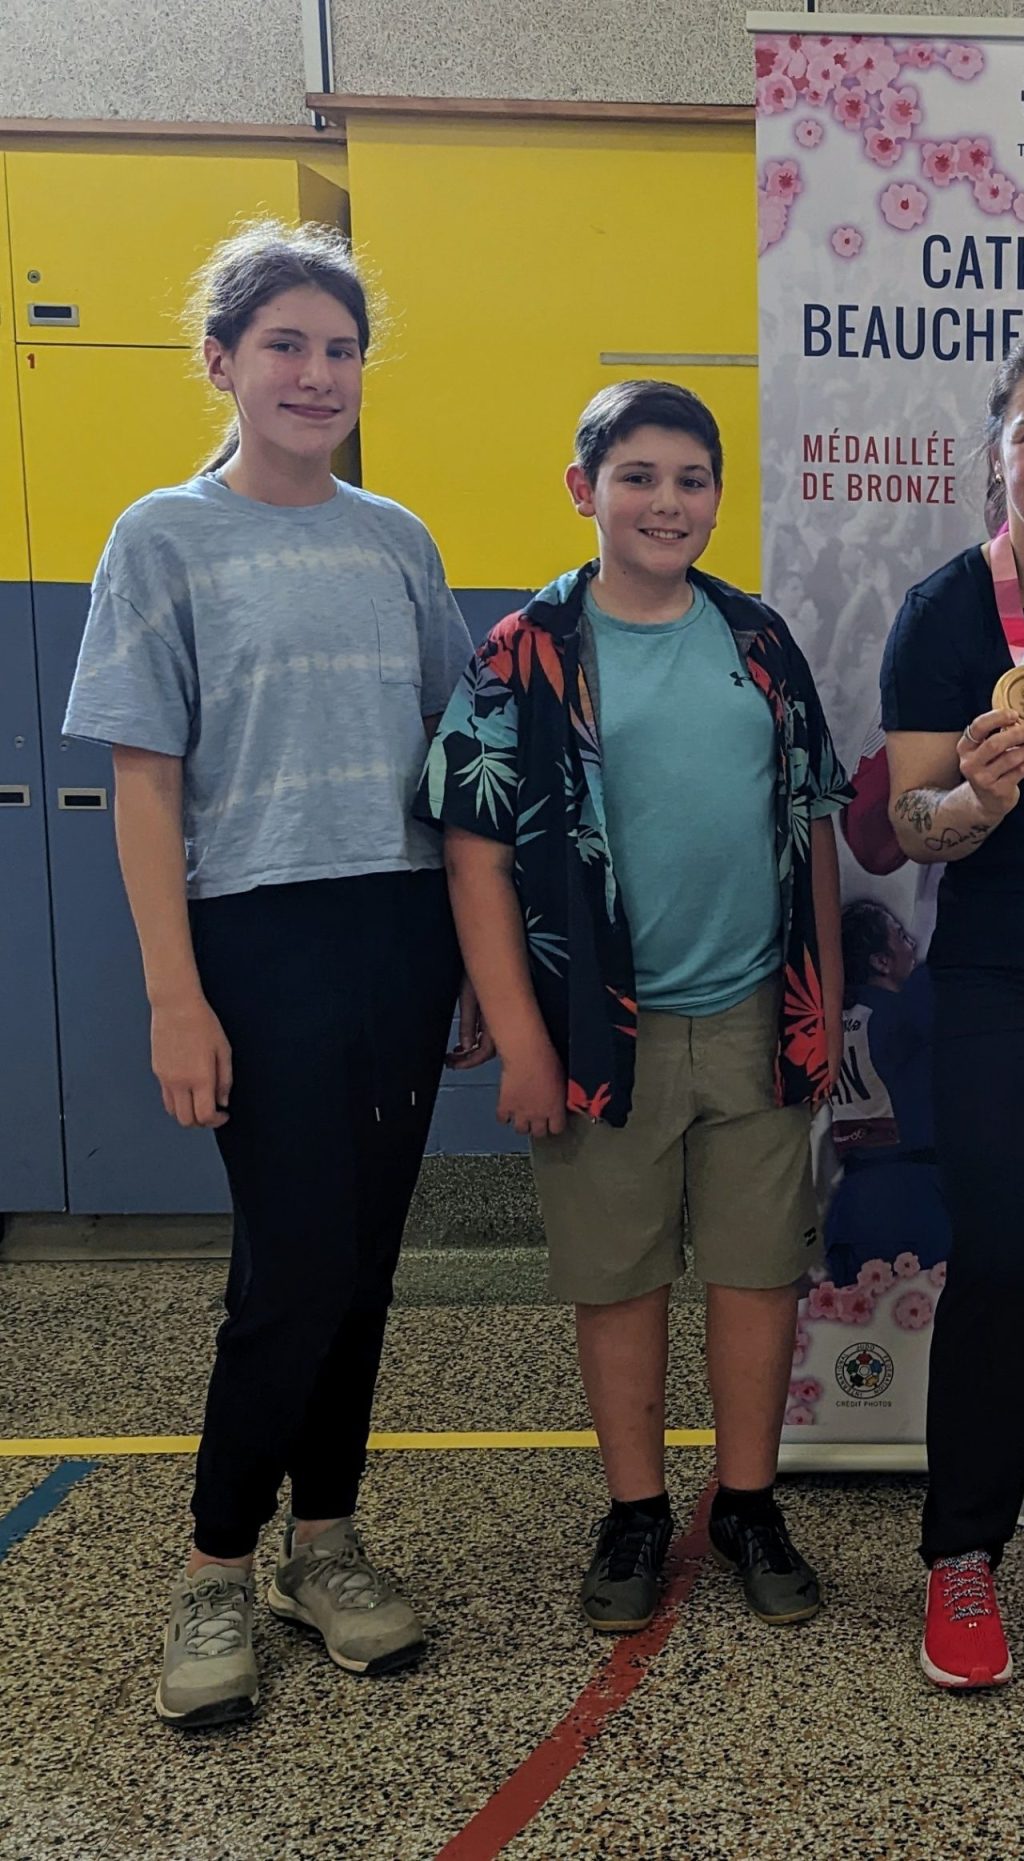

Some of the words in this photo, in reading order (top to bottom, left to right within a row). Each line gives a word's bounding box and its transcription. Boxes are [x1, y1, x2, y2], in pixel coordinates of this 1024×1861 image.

[27, 353, 35, 369] 1
[803, 428, 955, 466] MÉDAILLÉE
[803, 472, 834, 501] DE
[848, 474, 955, 504] BRONZE
